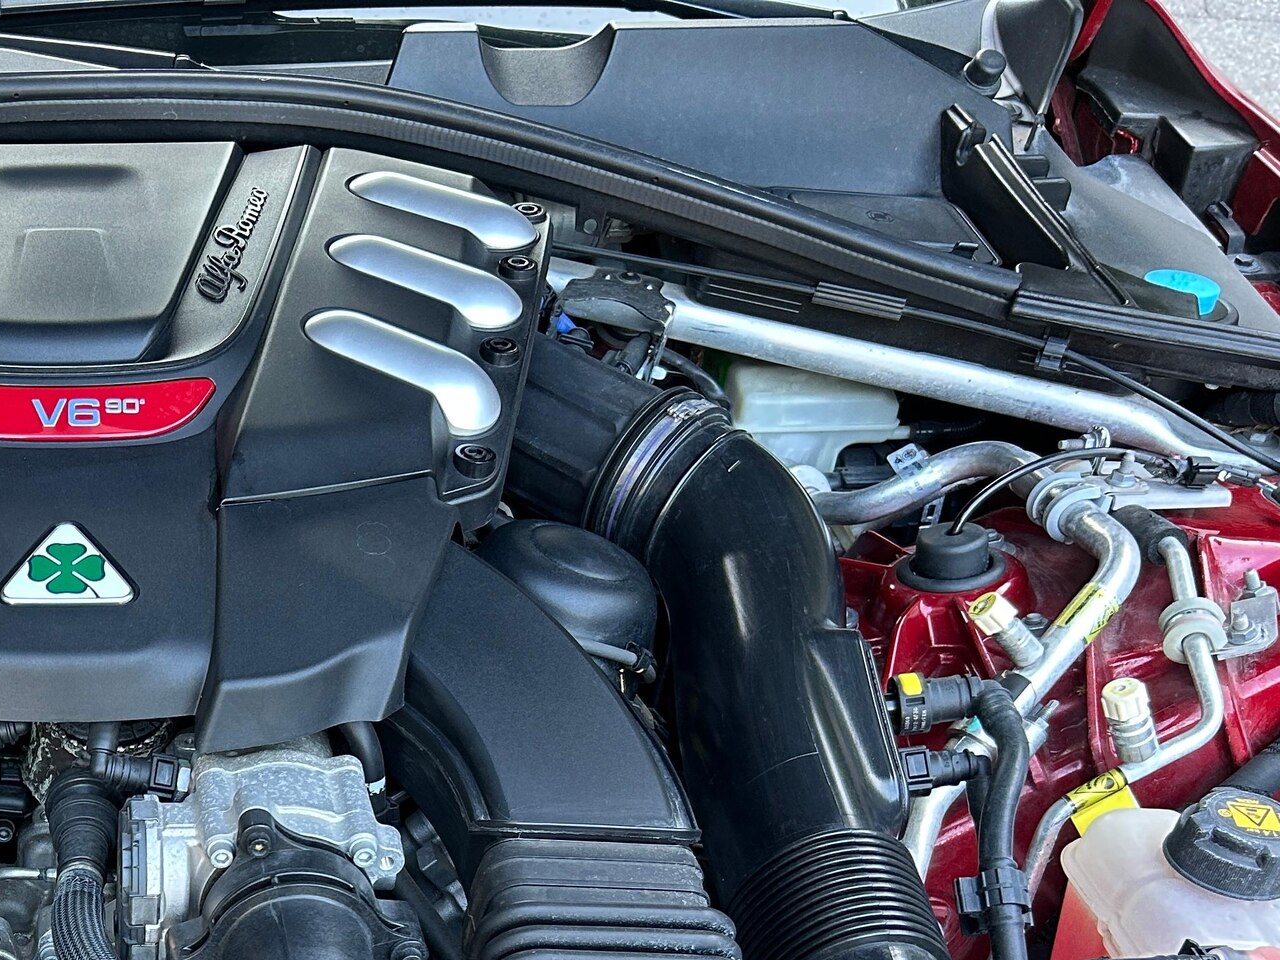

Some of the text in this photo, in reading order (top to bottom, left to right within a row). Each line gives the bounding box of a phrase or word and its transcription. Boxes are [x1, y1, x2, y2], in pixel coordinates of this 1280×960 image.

[195, 186, 269, 303] Alfa Romeo
[31, 398, 101, 427] V6
